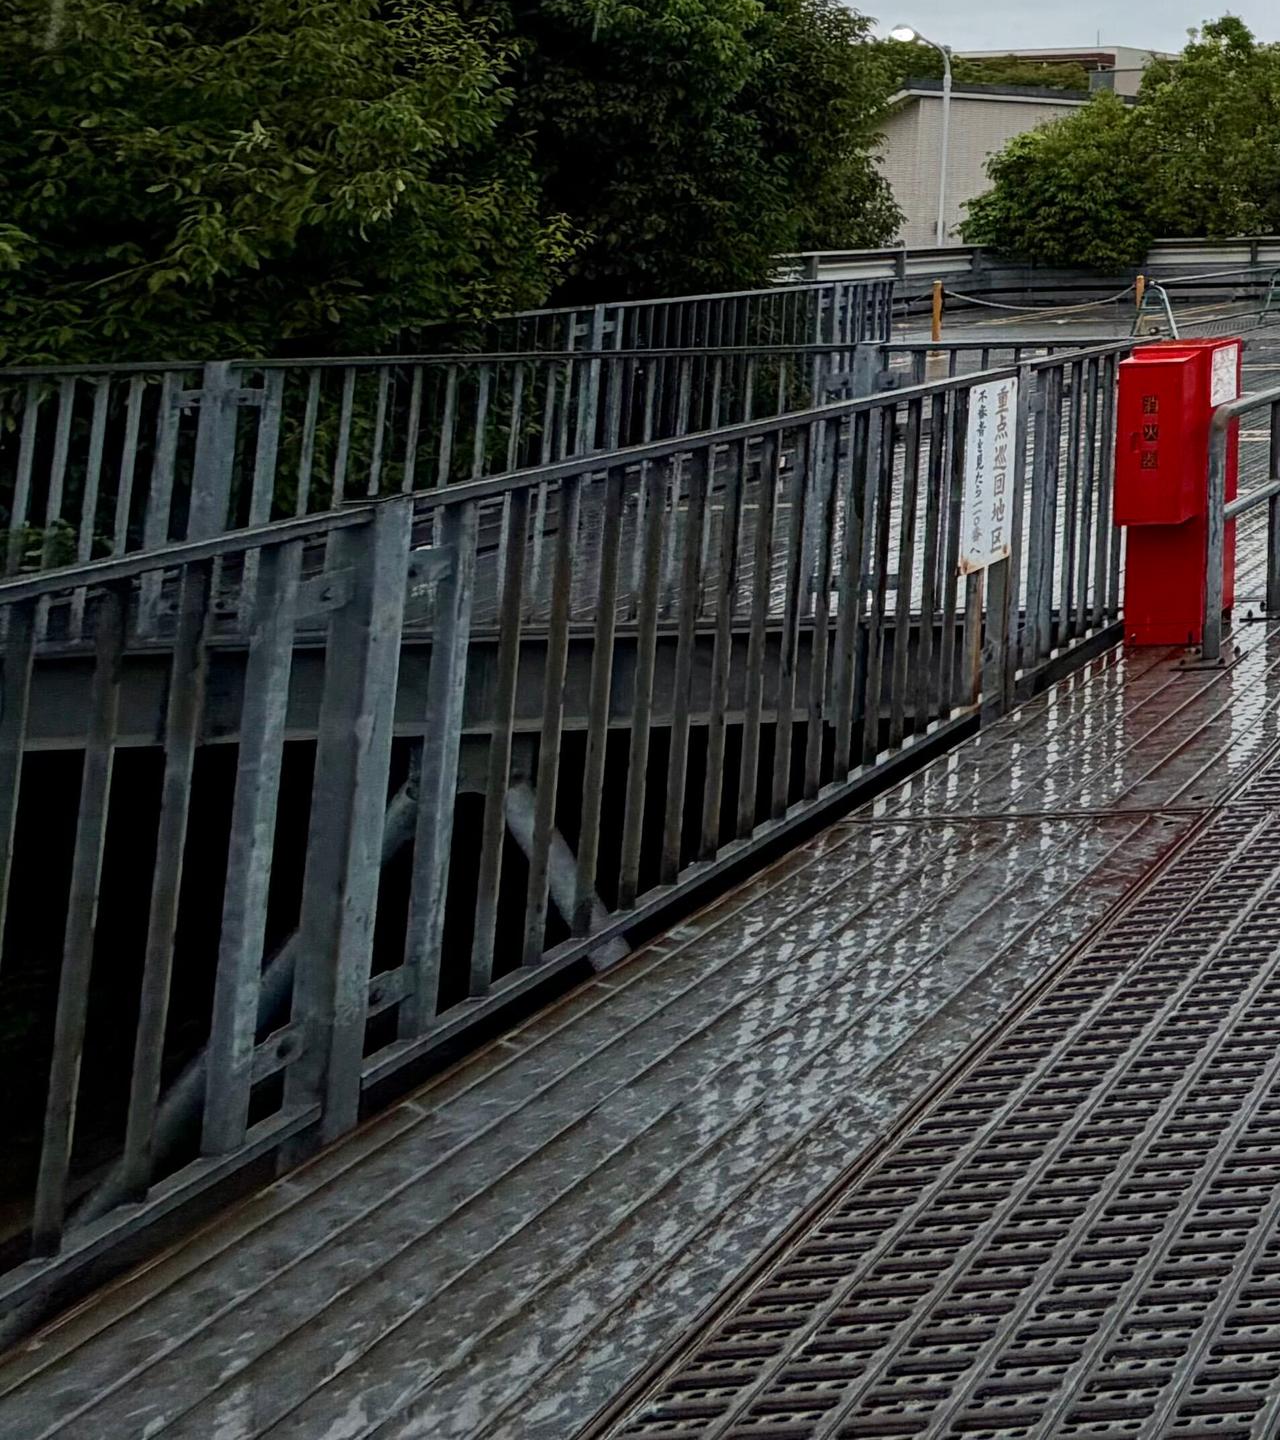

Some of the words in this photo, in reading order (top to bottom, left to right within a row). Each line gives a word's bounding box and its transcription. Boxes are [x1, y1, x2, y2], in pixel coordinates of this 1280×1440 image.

[991, 386, 1010, 554] 重点巡回地区
